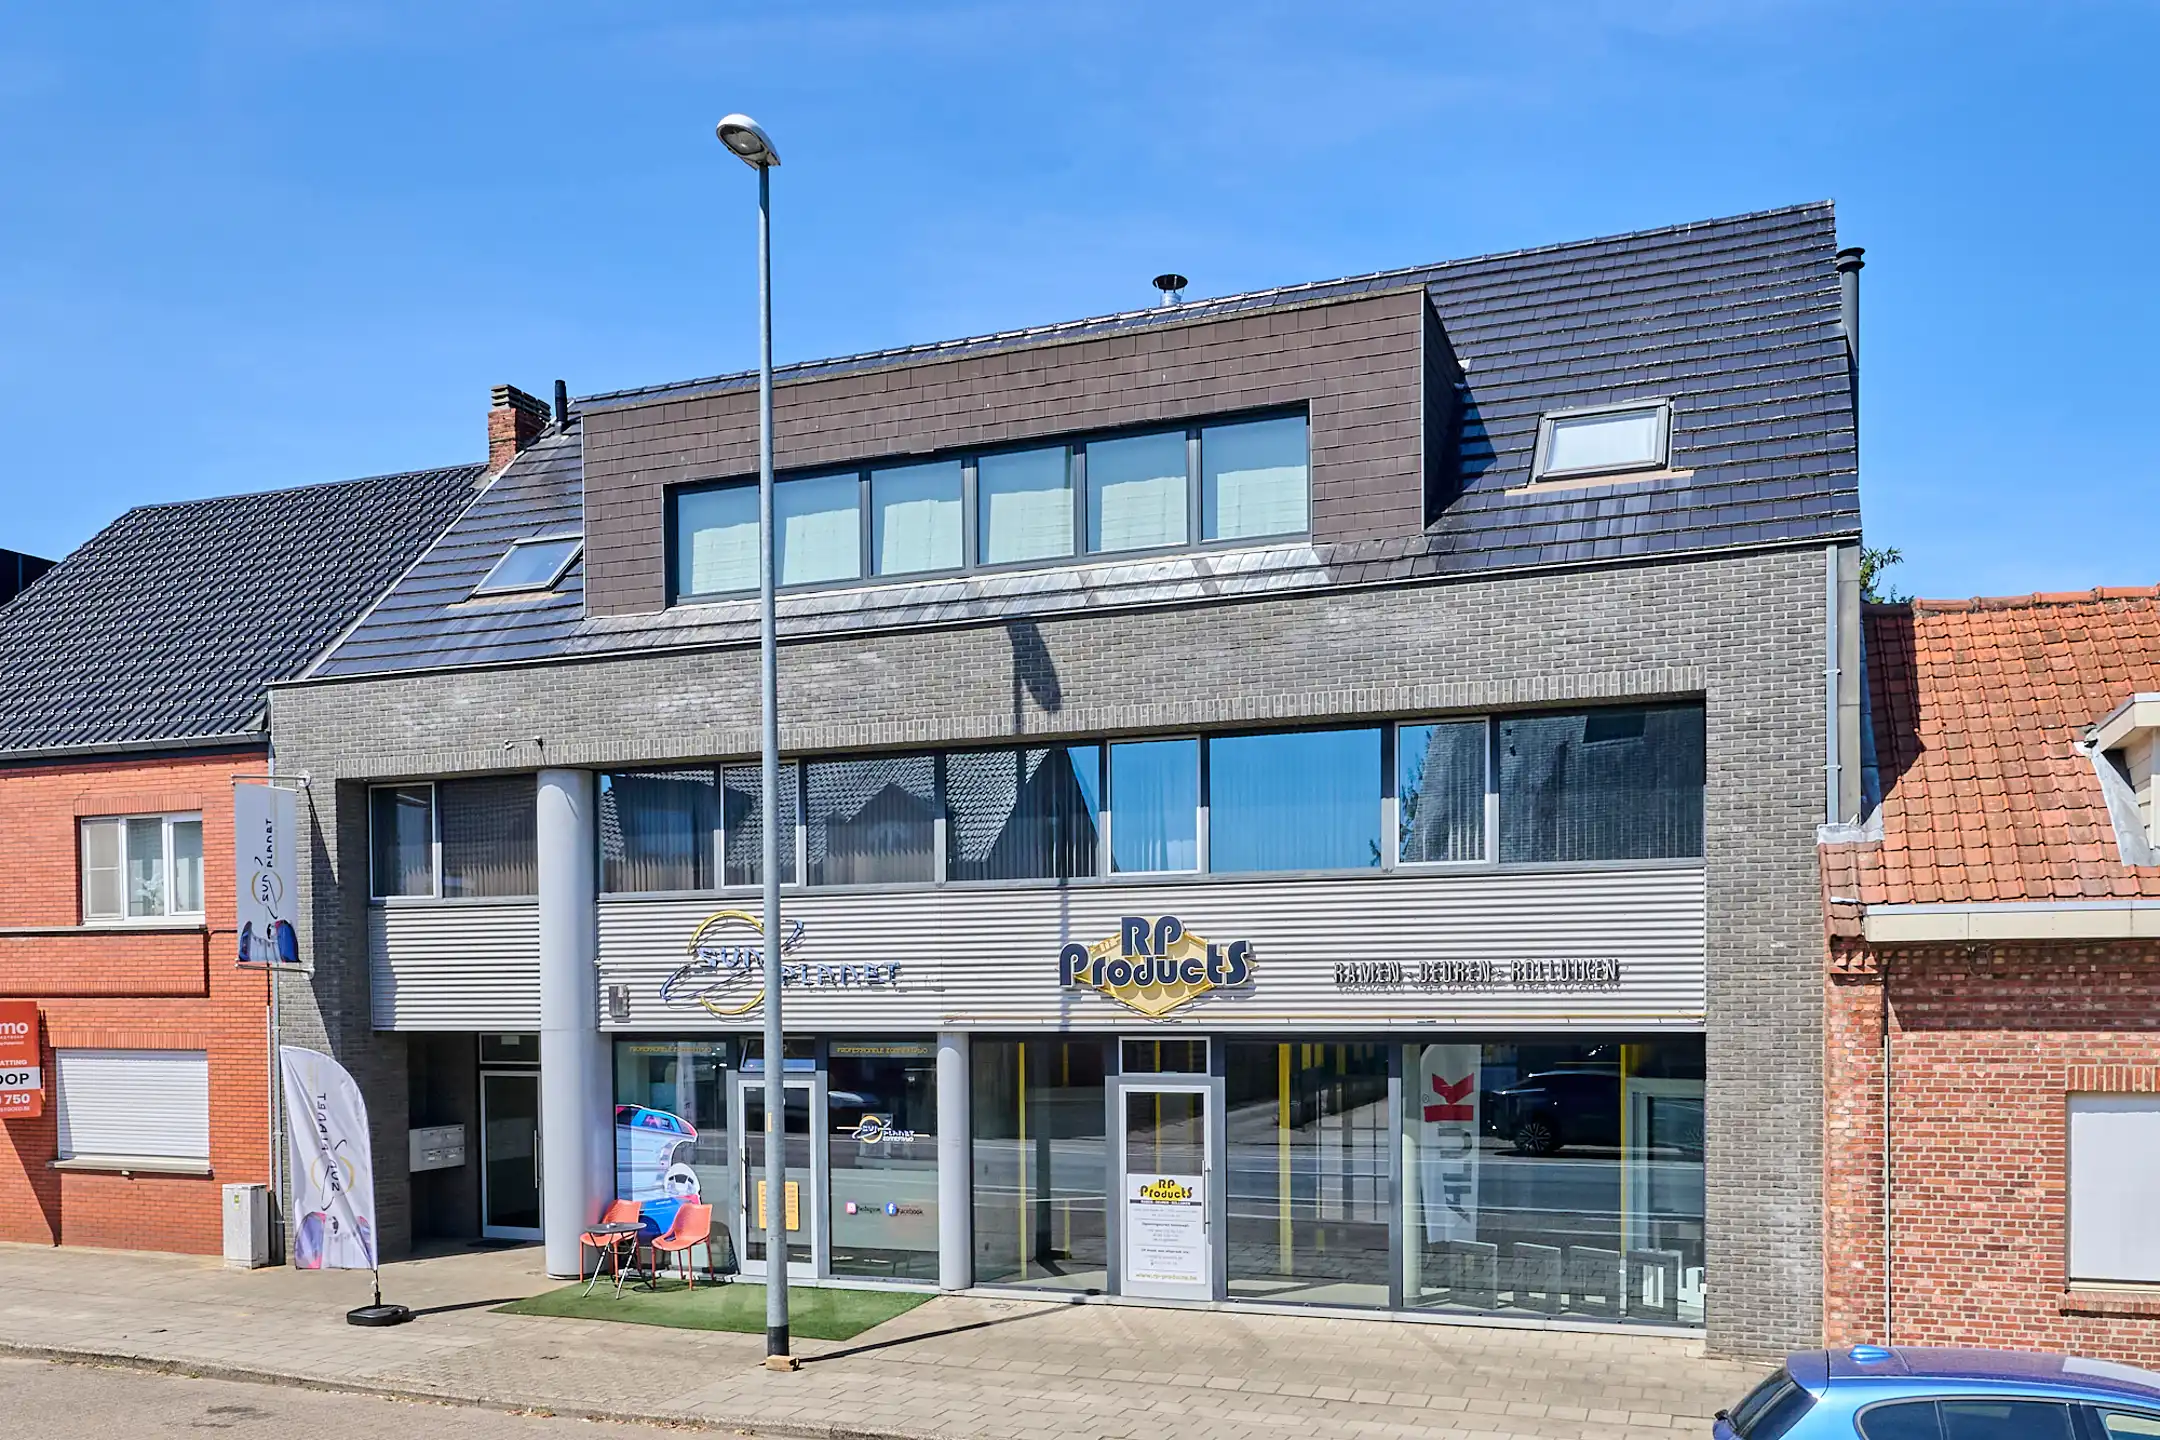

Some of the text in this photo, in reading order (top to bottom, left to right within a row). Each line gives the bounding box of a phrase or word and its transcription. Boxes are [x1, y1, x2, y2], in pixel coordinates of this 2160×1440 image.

[265, 818, 273, 868] PLANET
[261, 874, 269, 902] SUN
[1120, 915, 1185, 957] RP
[697, 946, 764, 968] SUN
[1059, 940, 1252, 989] Products
[781, 961, 901, 986] PLANET
[1334, 958, 1621, 984] RAMEN DEUREN ROLLUIKEN
[0, 1073, 29, 1085] OP
[4, 1094, 30, 1104] 750
[1140, 1185, 1193, 1199] Products
[1159, 1179, 1175, 1188] RP
